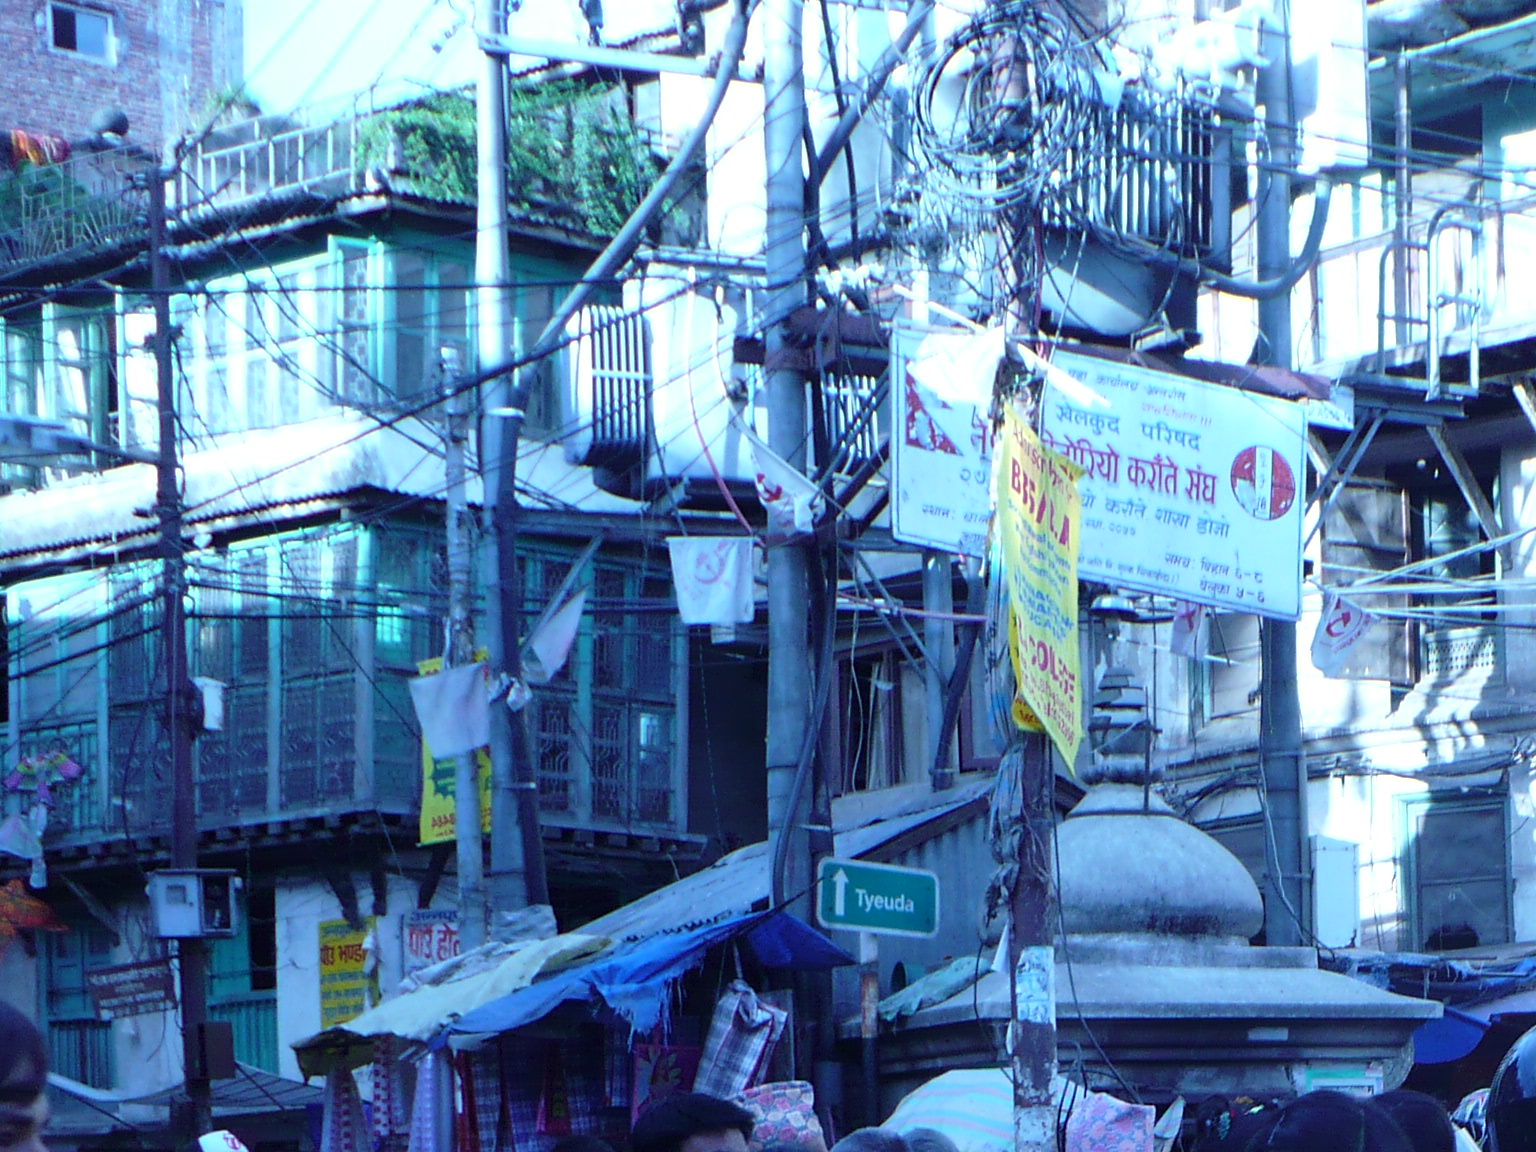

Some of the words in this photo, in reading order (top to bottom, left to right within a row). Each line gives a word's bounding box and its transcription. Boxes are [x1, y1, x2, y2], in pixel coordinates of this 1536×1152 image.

[1056, 403, 1121, 435] खेलकुद
[1141, 421, 1202, 451] परिषद
[1185, 464, 1219, 504] संघ
[855, 887, 915, 914] Tyeuda
[337, 943, 368, 963] भण्डा
